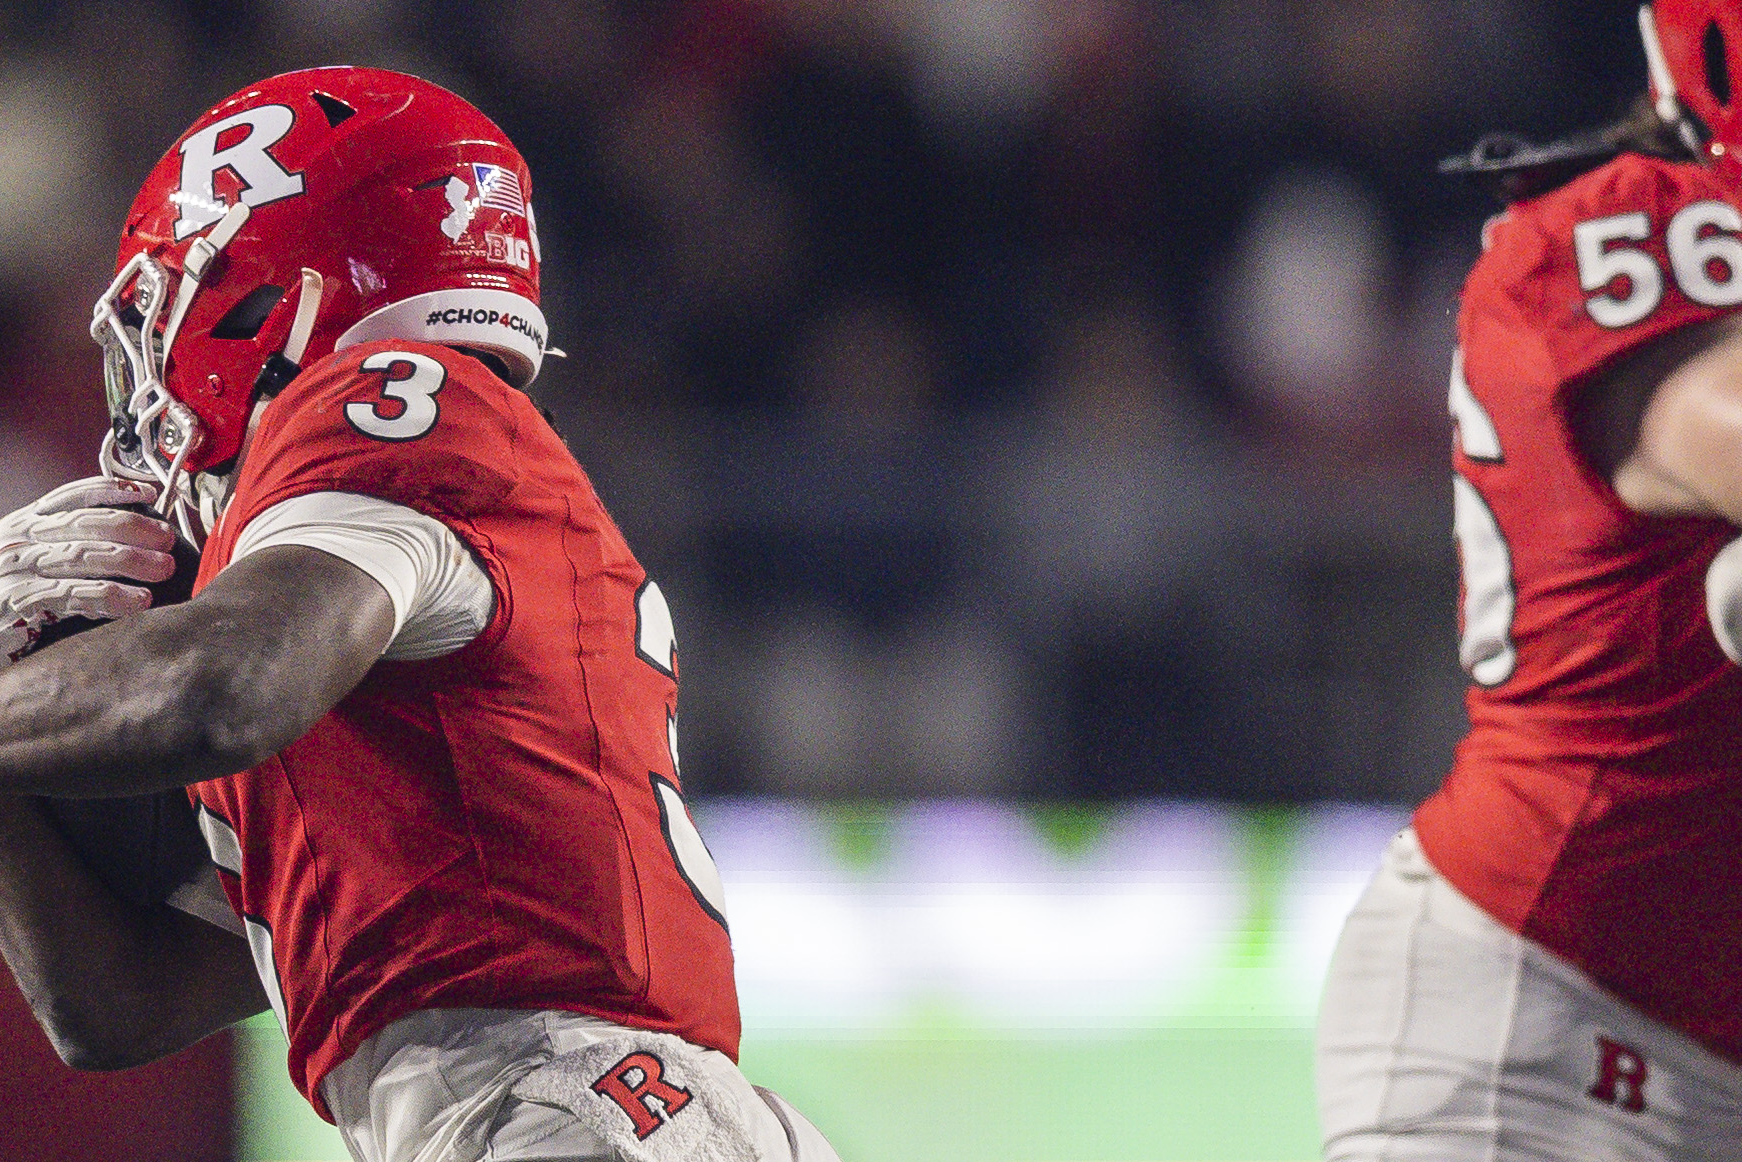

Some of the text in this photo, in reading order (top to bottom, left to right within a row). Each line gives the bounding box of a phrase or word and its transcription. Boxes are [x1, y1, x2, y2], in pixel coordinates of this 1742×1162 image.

[173, 104, 306, 241] R
[1573, 201, 1742, 328] 56
[344, 351, 448, 441] 3
[591, 1050, 692, 1142] R
[1586, 1034, 1649, 1114] R
